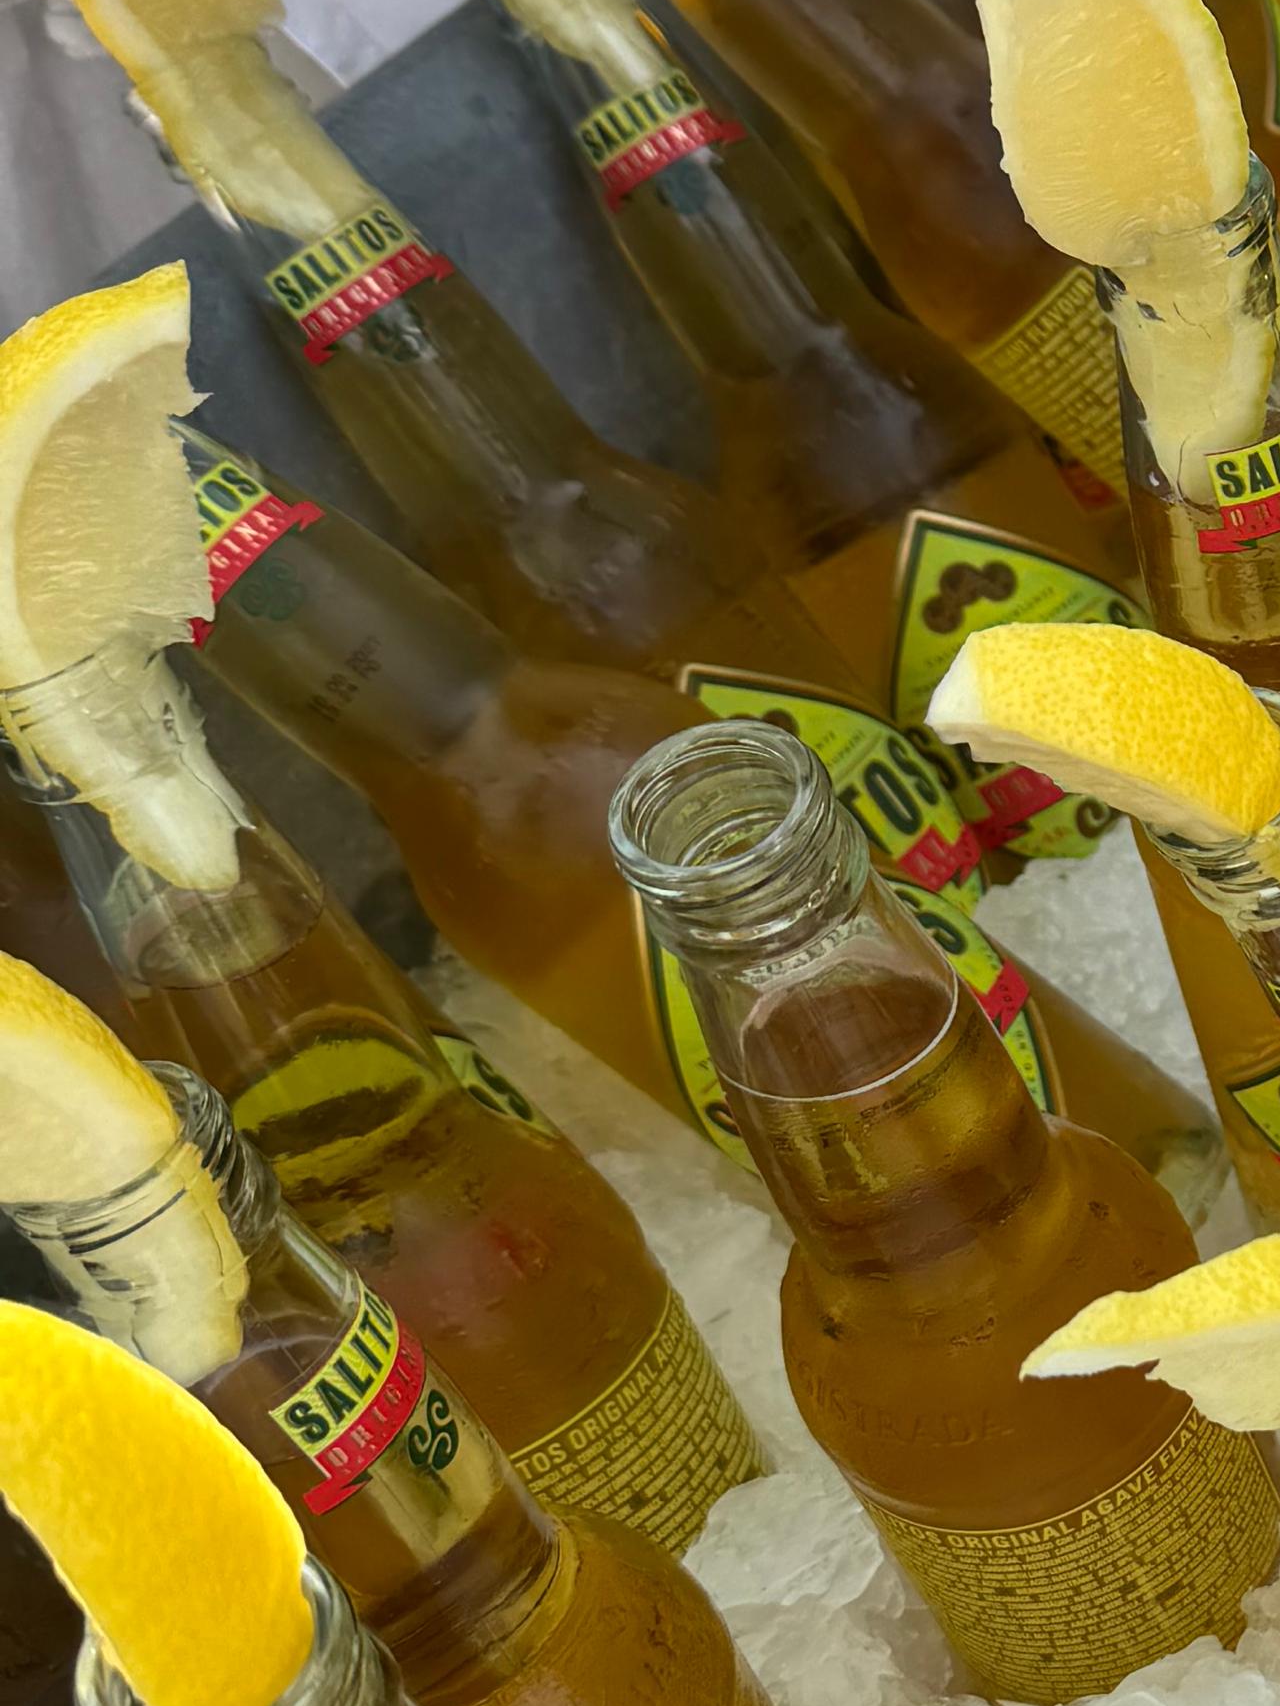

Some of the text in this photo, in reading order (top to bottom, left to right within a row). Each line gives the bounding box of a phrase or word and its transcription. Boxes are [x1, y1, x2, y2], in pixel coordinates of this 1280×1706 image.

[273, 208, 404, 311] SALITOS
[567, 1359, 659, 1453] ORIGINAL
[946, 1516, 1077, 1551] ORIGINAL
[1080, 1463, 1159, 1524] AGAVE
